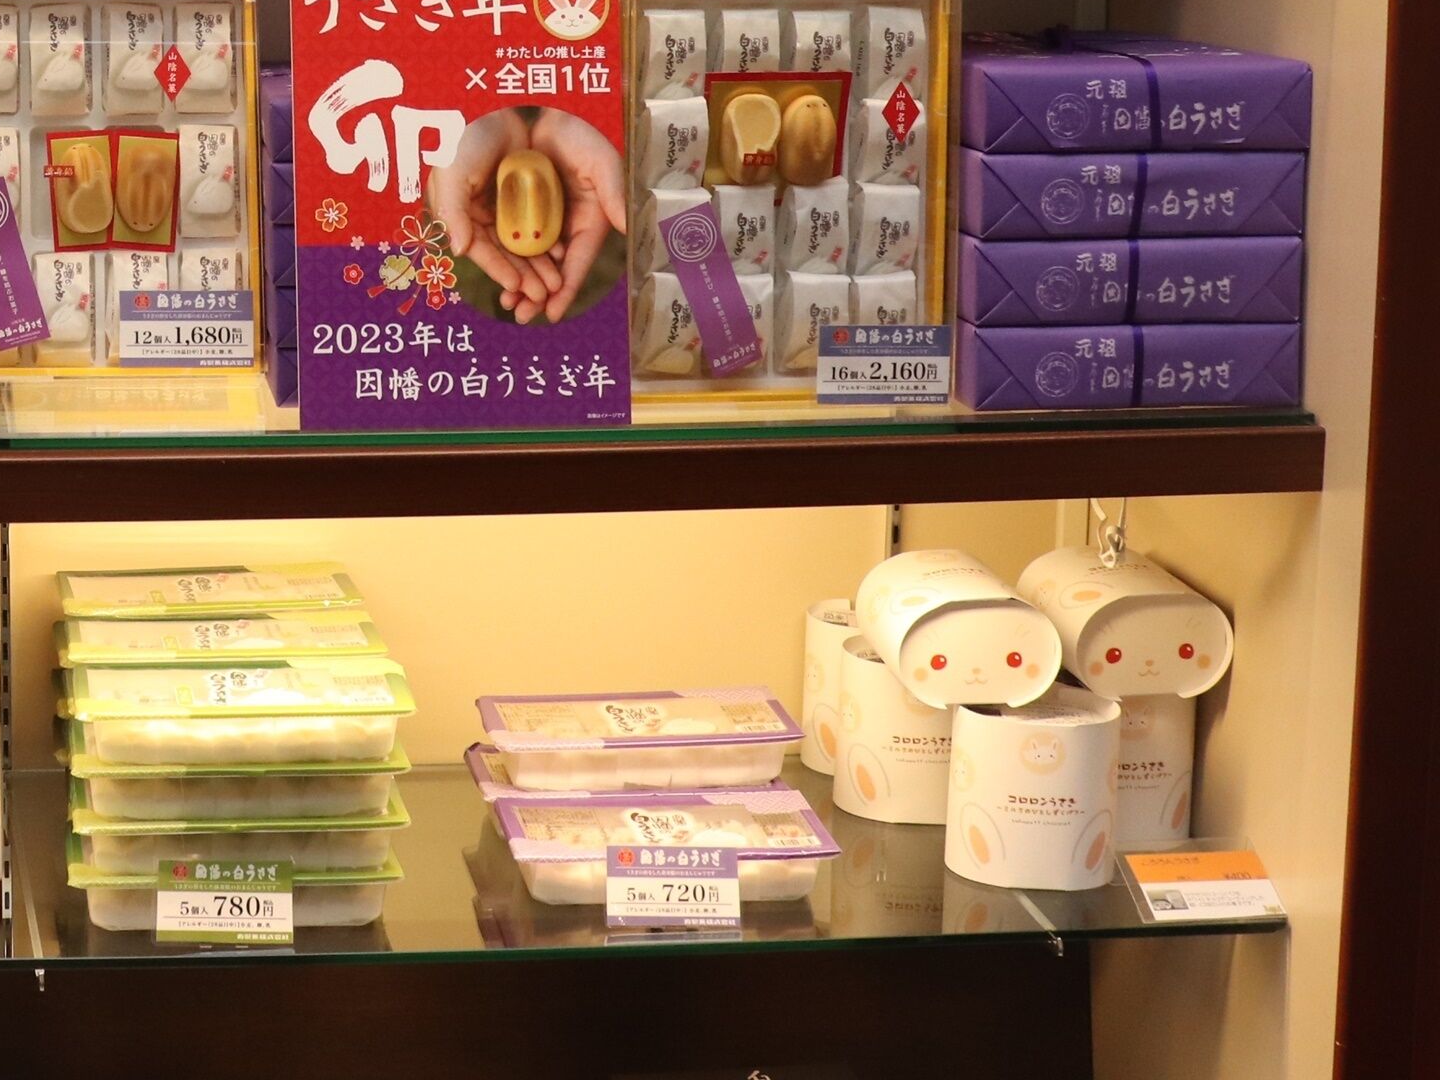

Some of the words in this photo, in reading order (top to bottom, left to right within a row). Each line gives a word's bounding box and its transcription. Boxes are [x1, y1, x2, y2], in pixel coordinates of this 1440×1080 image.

[496, 45, 606, 60] #わたしの推し土産
[167, 52, 178, 94] 山陰名菓
[308, 59, 465, 202] 卯
[896, 90, 906, 134] 山陰名菓
[313, 322, 474, 356] 2023年は
[355, 362, 616, 401] 因幡の白うさぎ年
